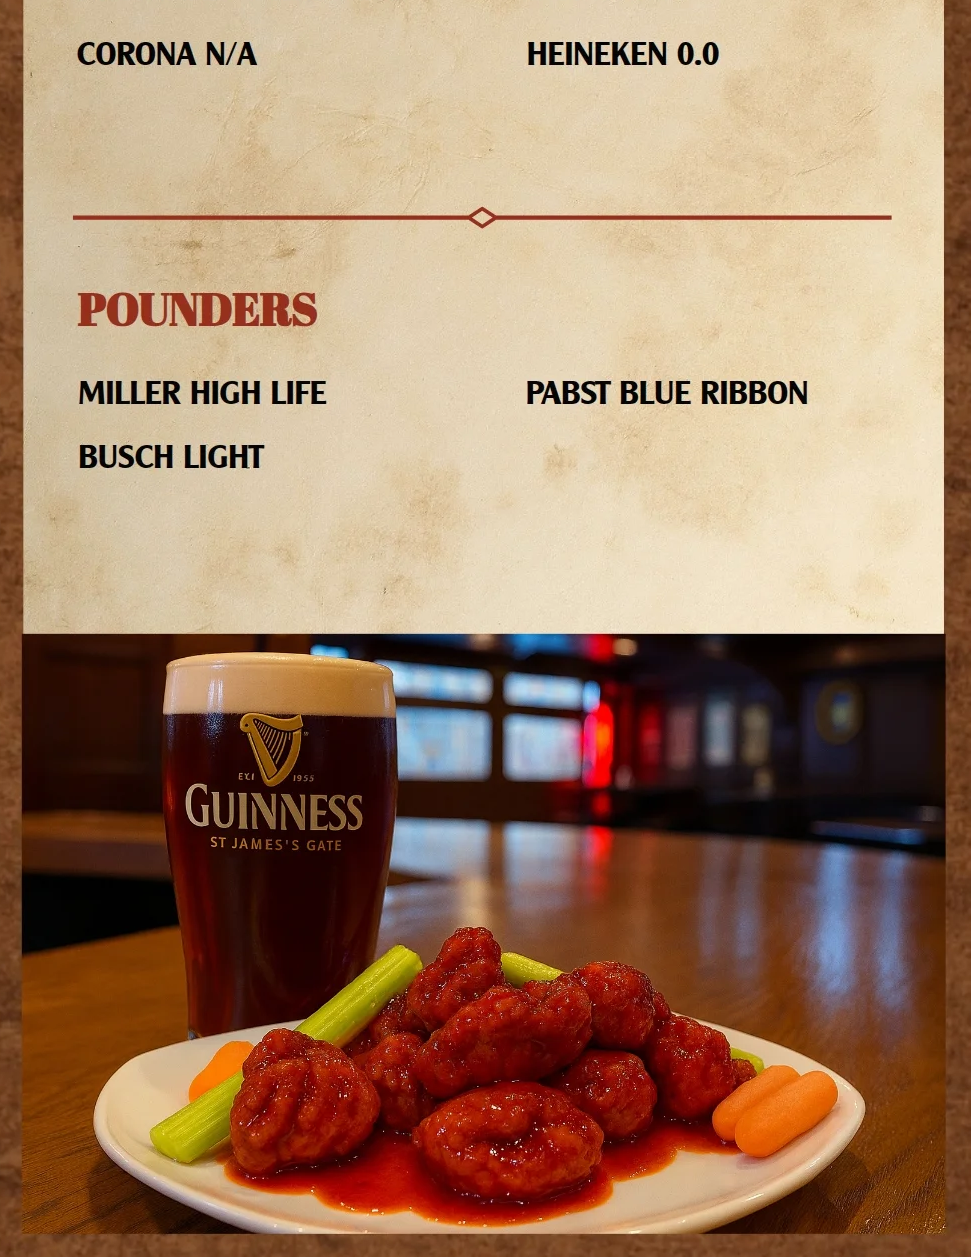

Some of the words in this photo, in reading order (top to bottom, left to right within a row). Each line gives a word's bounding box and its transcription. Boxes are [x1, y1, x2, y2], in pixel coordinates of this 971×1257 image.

[77, 42, 197, 65] CORONA
[207, 42, 257, 65] N/A
[528, 42, 667, 65] HEINEKEN
[677, 42, 719, 65] 0.0
[78, 292, 317, 327] POUNDERS
[79, 381, 181, 404] MILLER
[191, 381, 260, 404] HIGH
[272, 381, 327, 404] LIFE
[527, 381, 611, 404] PABST
[621, 381, 691, 404] BLUE
[702, 381, 807, 404] RIBBON
[185, 783, 363, 831] GUINNESS
[210, 836, 226, 849] ST
[232, 837, 300, 851] JAMES'S
[306, 839, 342, 852] GATE
